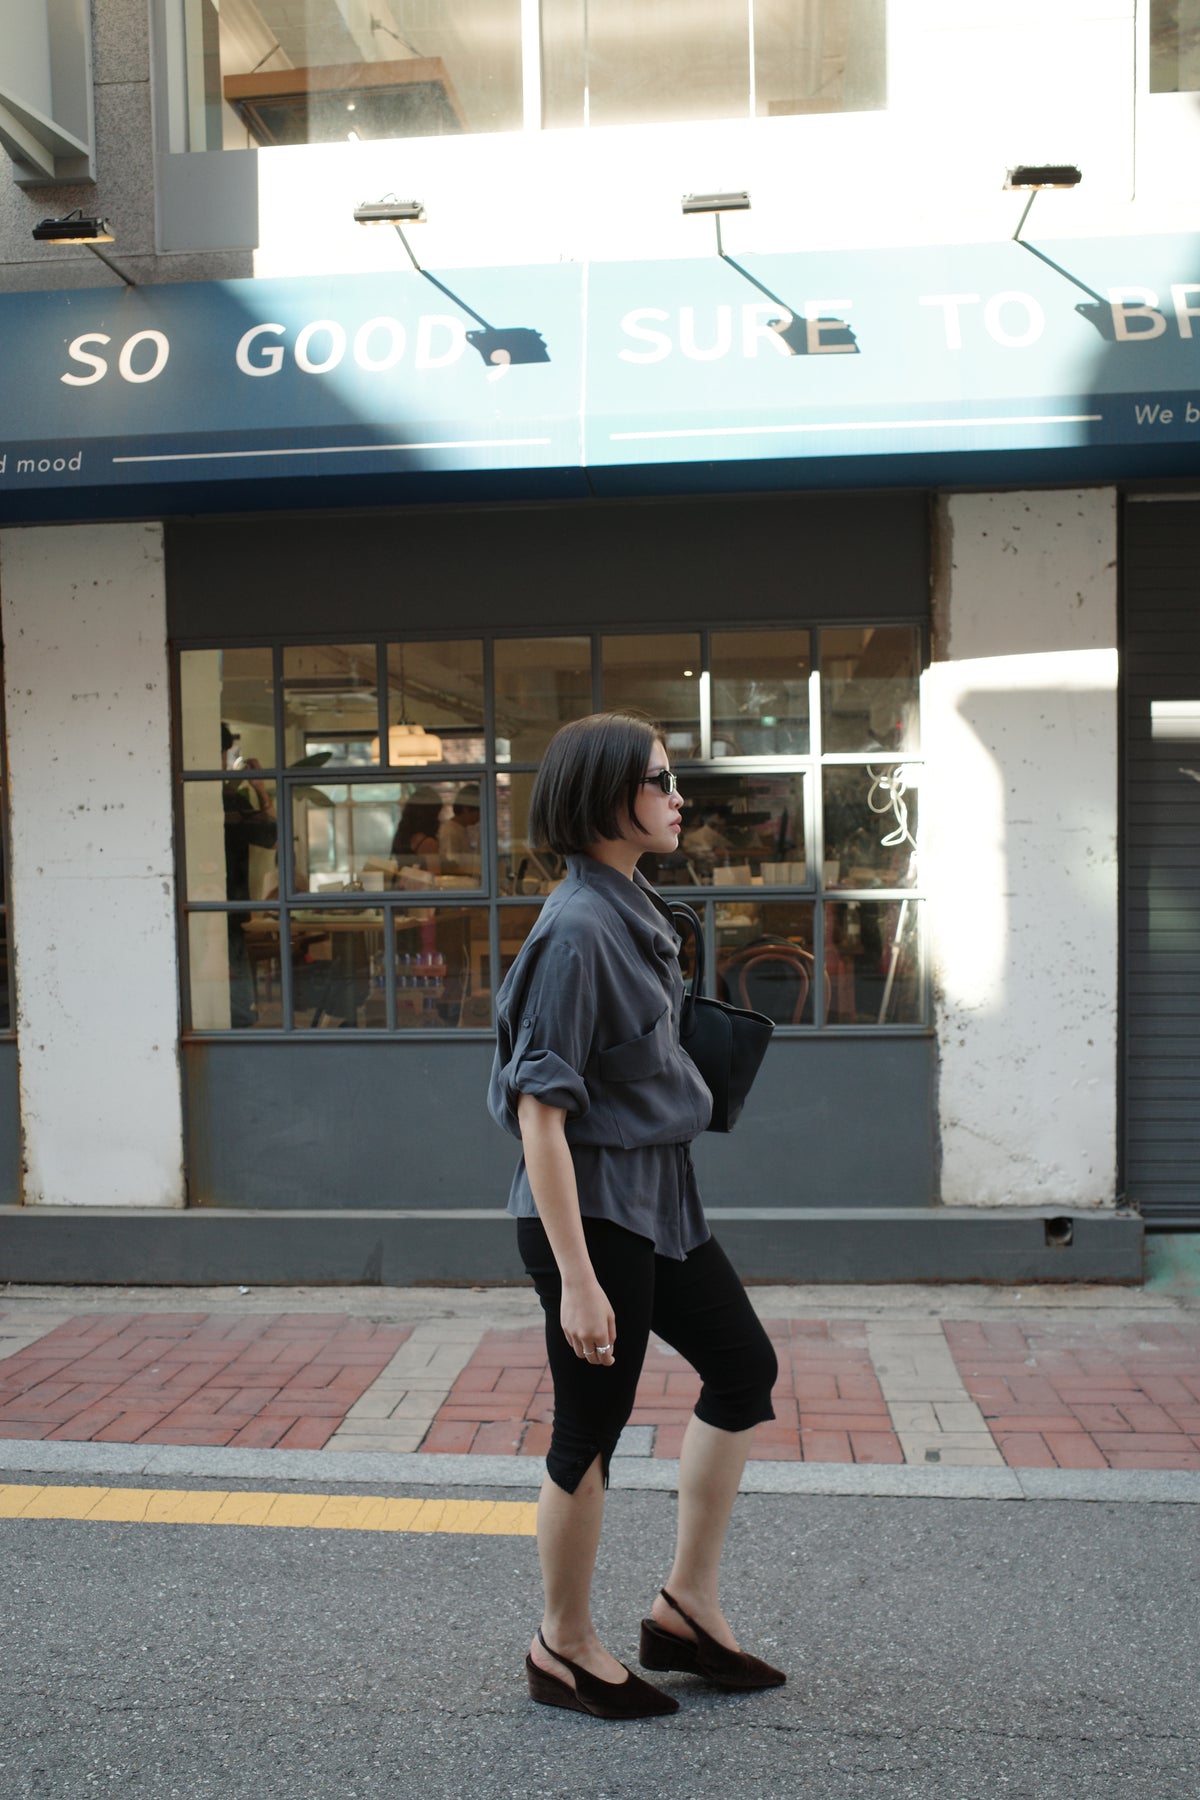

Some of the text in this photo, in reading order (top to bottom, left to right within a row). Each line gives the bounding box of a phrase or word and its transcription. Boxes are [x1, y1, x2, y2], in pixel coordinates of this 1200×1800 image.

[60, 329, 171, 387] SO
[236, 315, 510, 381] GOOD,
[617, 300, 857, 364] SURE
[918, 292, 1045, 350] TO
[1134, 401, 1200, 425] We b
[16, 450, 83, 473] mood
